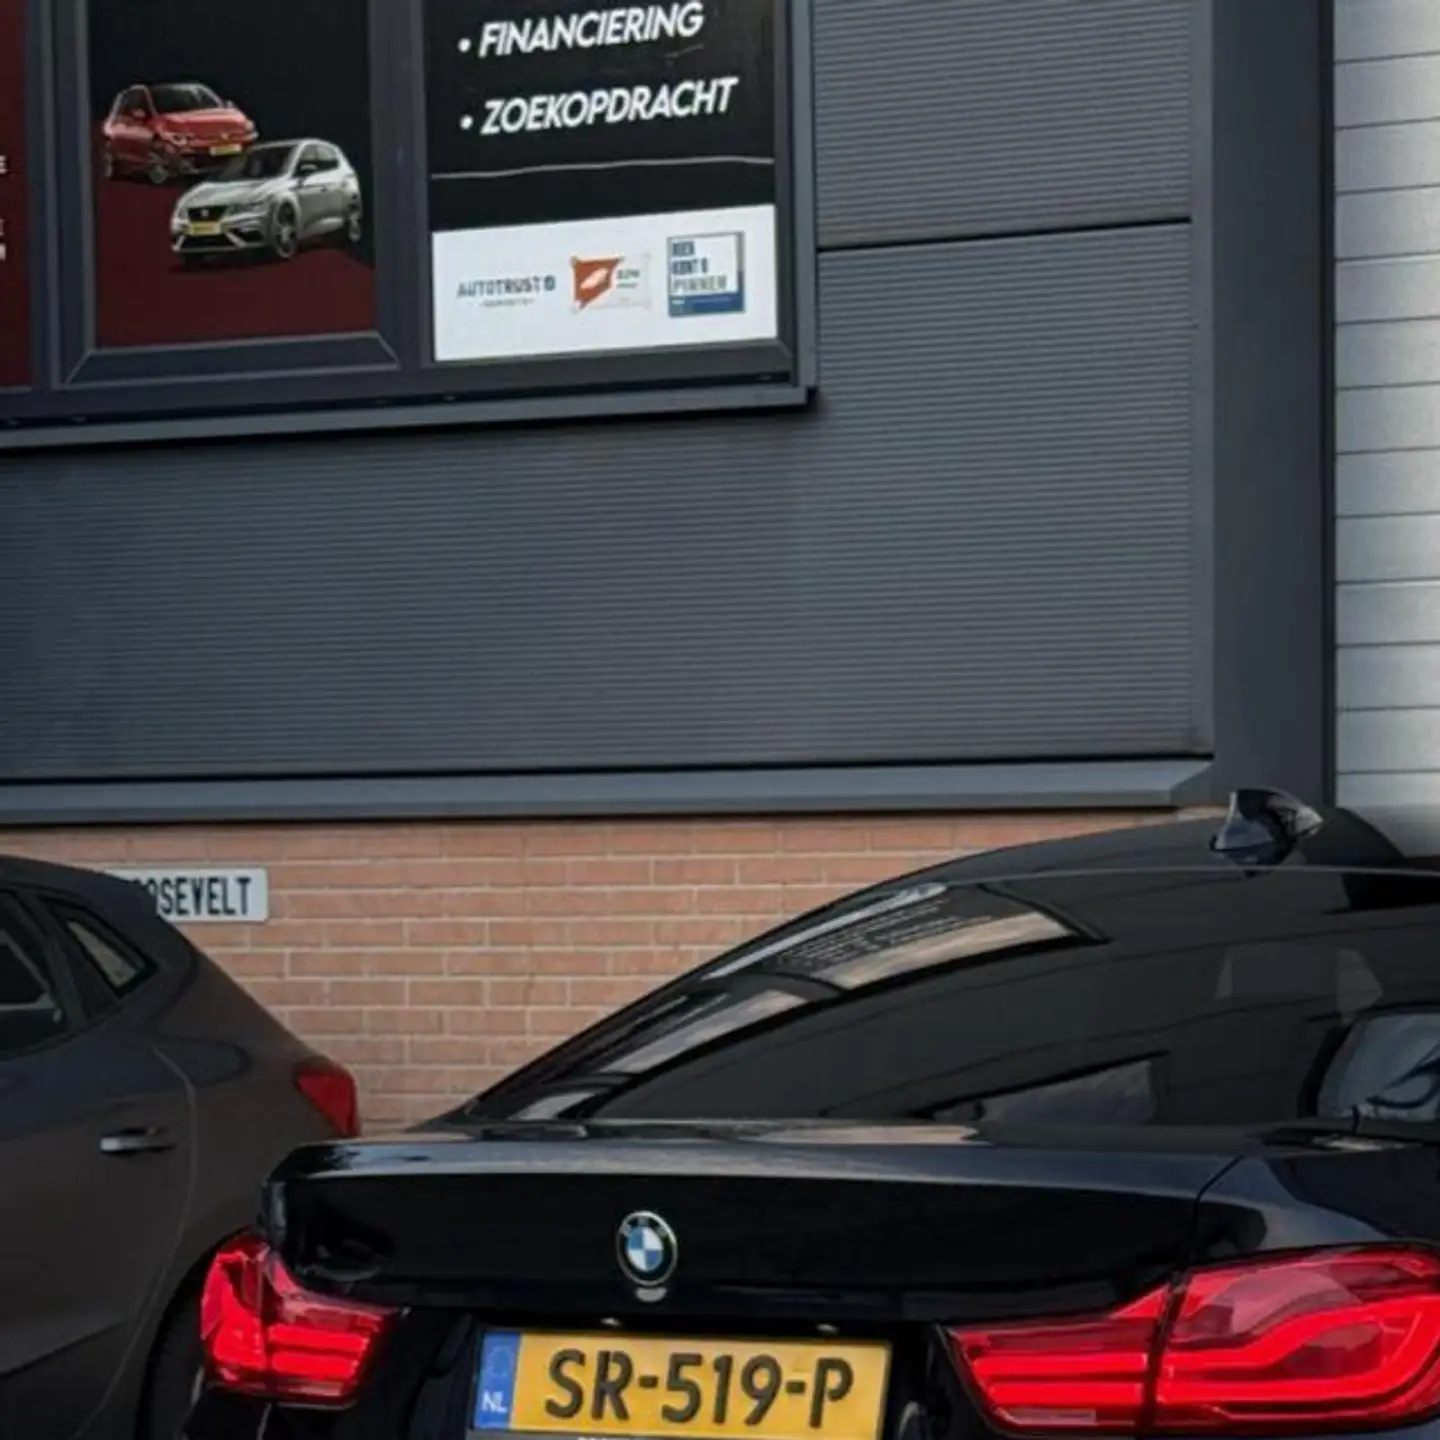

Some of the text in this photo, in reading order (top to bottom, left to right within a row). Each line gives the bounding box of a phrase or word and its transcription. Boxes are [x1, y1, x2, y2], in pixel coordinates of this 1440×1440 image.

[478, 0, 704, 58] FINANCIERING
[480, 76, 739, 135] ZOEKOPDRACHT
[481, 1390, 507, 1414] NL
[545, 1348, 854, 1428] SR-519-P
